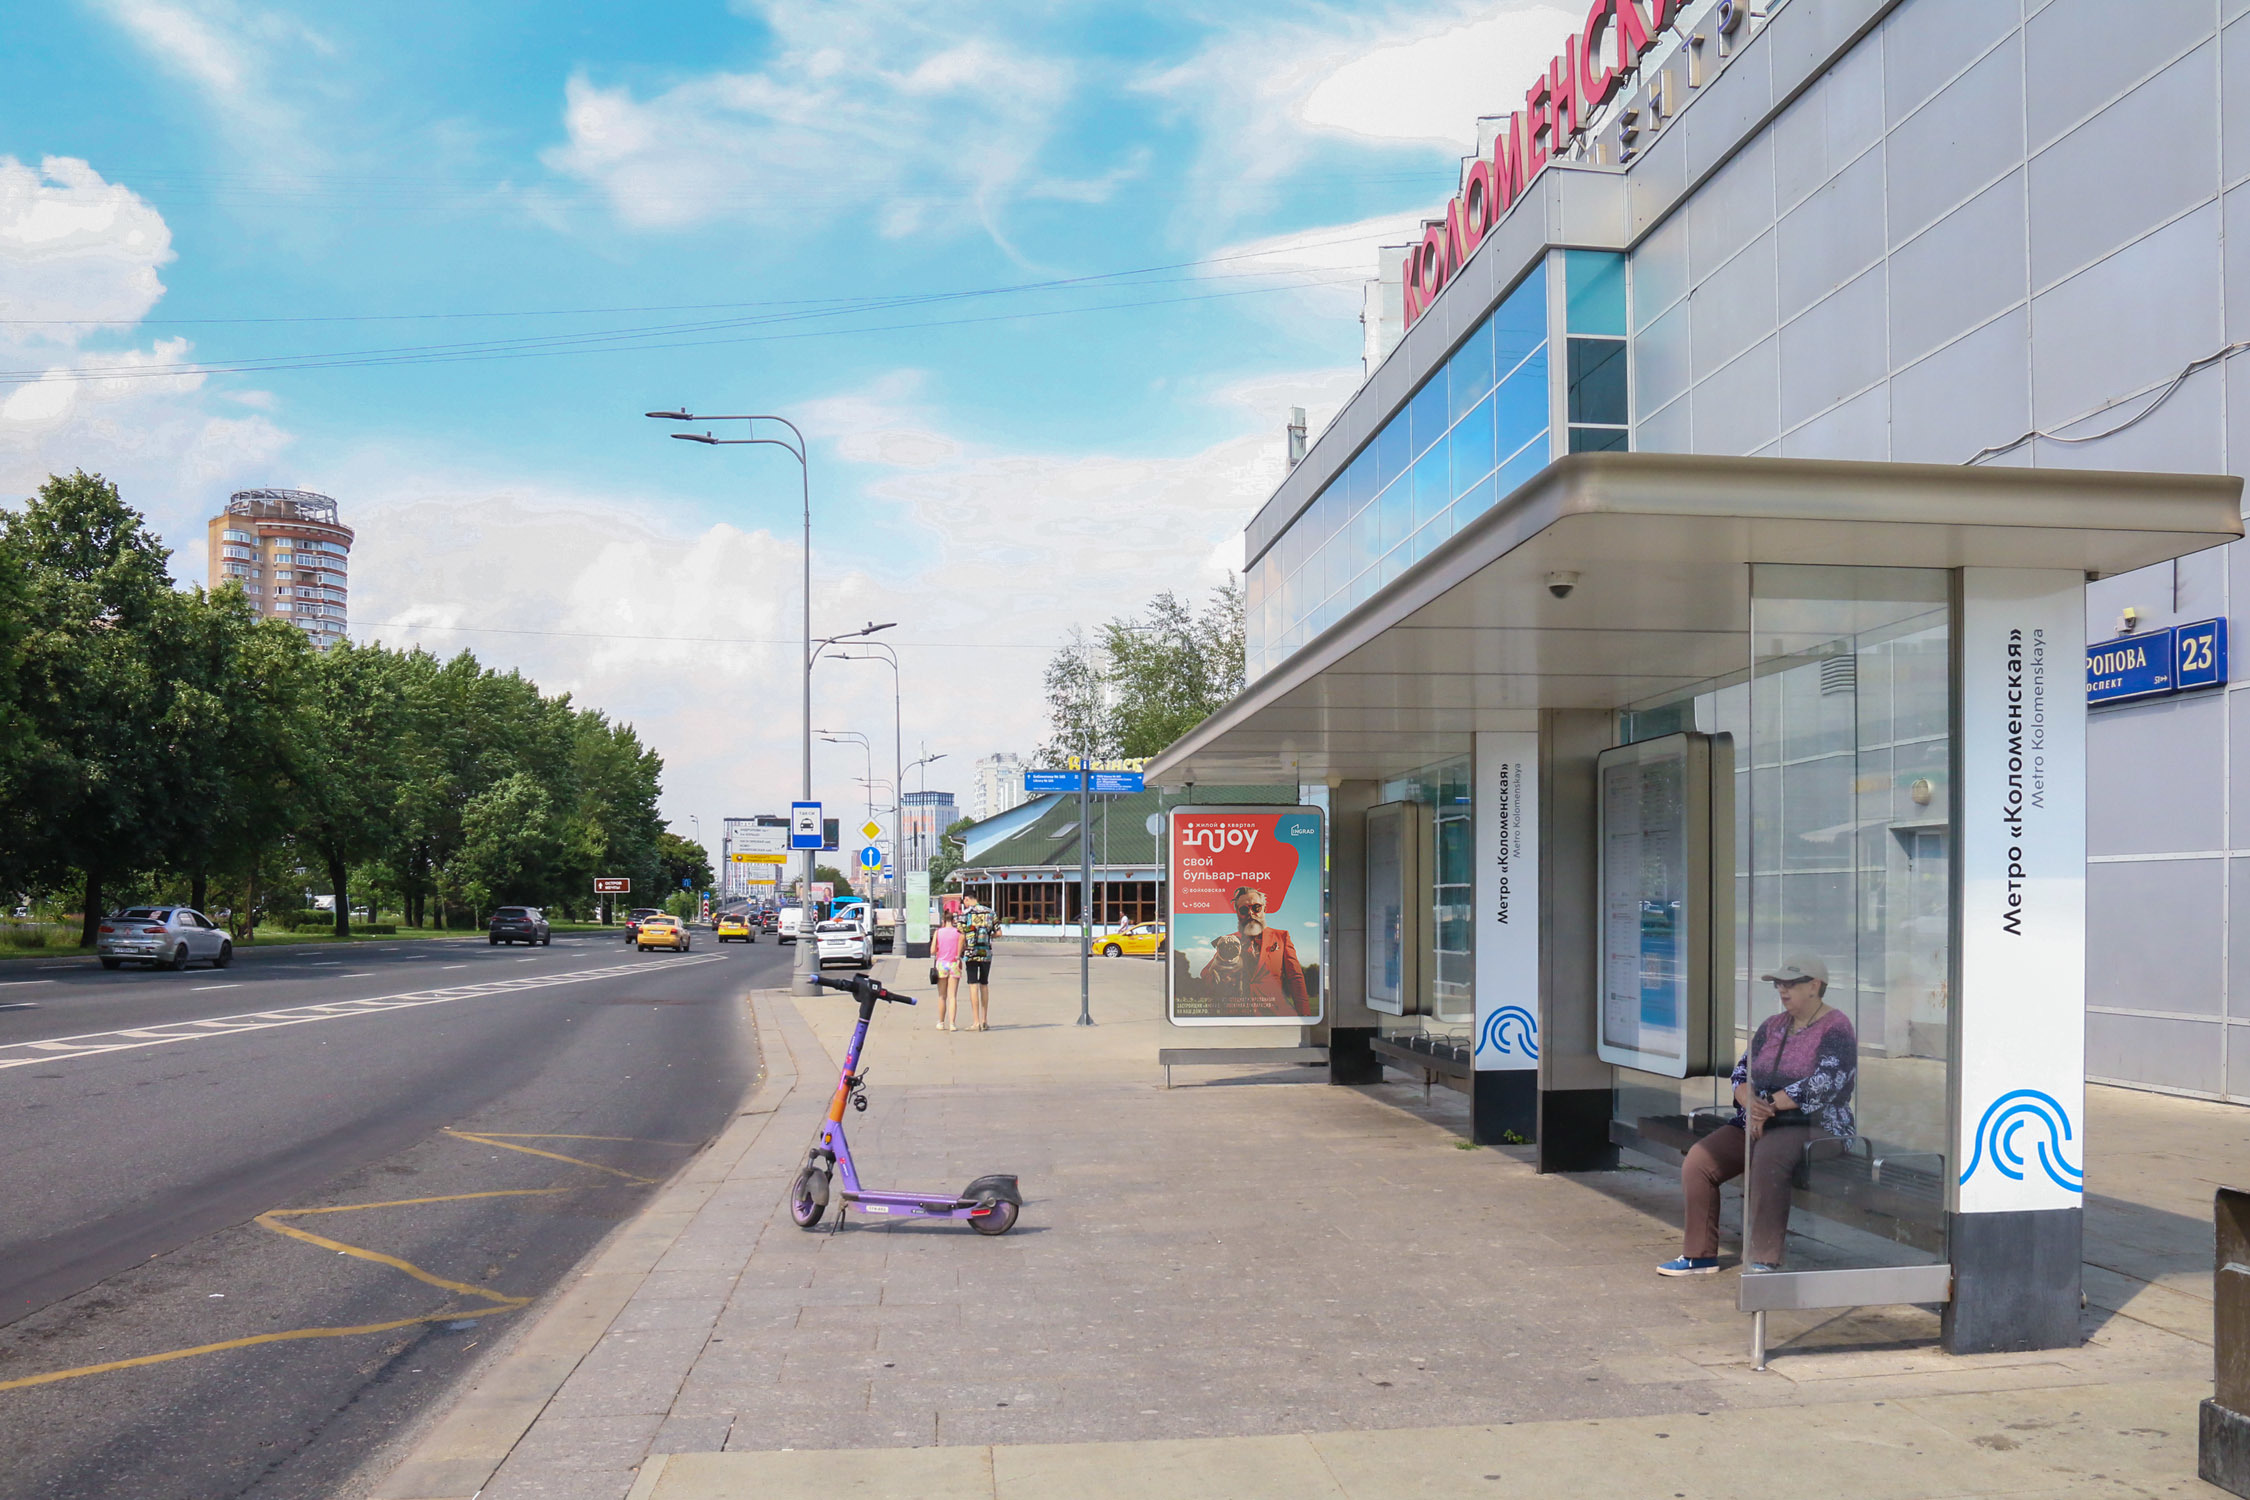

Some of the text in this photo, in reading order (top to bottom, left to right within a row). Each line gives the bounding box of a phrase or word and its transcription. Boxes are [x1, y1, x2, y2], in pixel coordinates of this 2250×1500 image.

[1403, 0, 1686, 330] КОЛОМЕНСК
[2182, 634, 2213, 672] 23
[2003, 628, 2026, 936] Метро «Коломенская»
[2031, 628, 2047, 809] Metro Kolomenskaya
[1183, 856, 1213, 866] свой
[1498, 763, 1511, 925] Метро «Коломенская»
[1513, 763, 1522, 858] Metro Kolomenskaya
[1183, 870, 1271, 882] бульвар-парк
